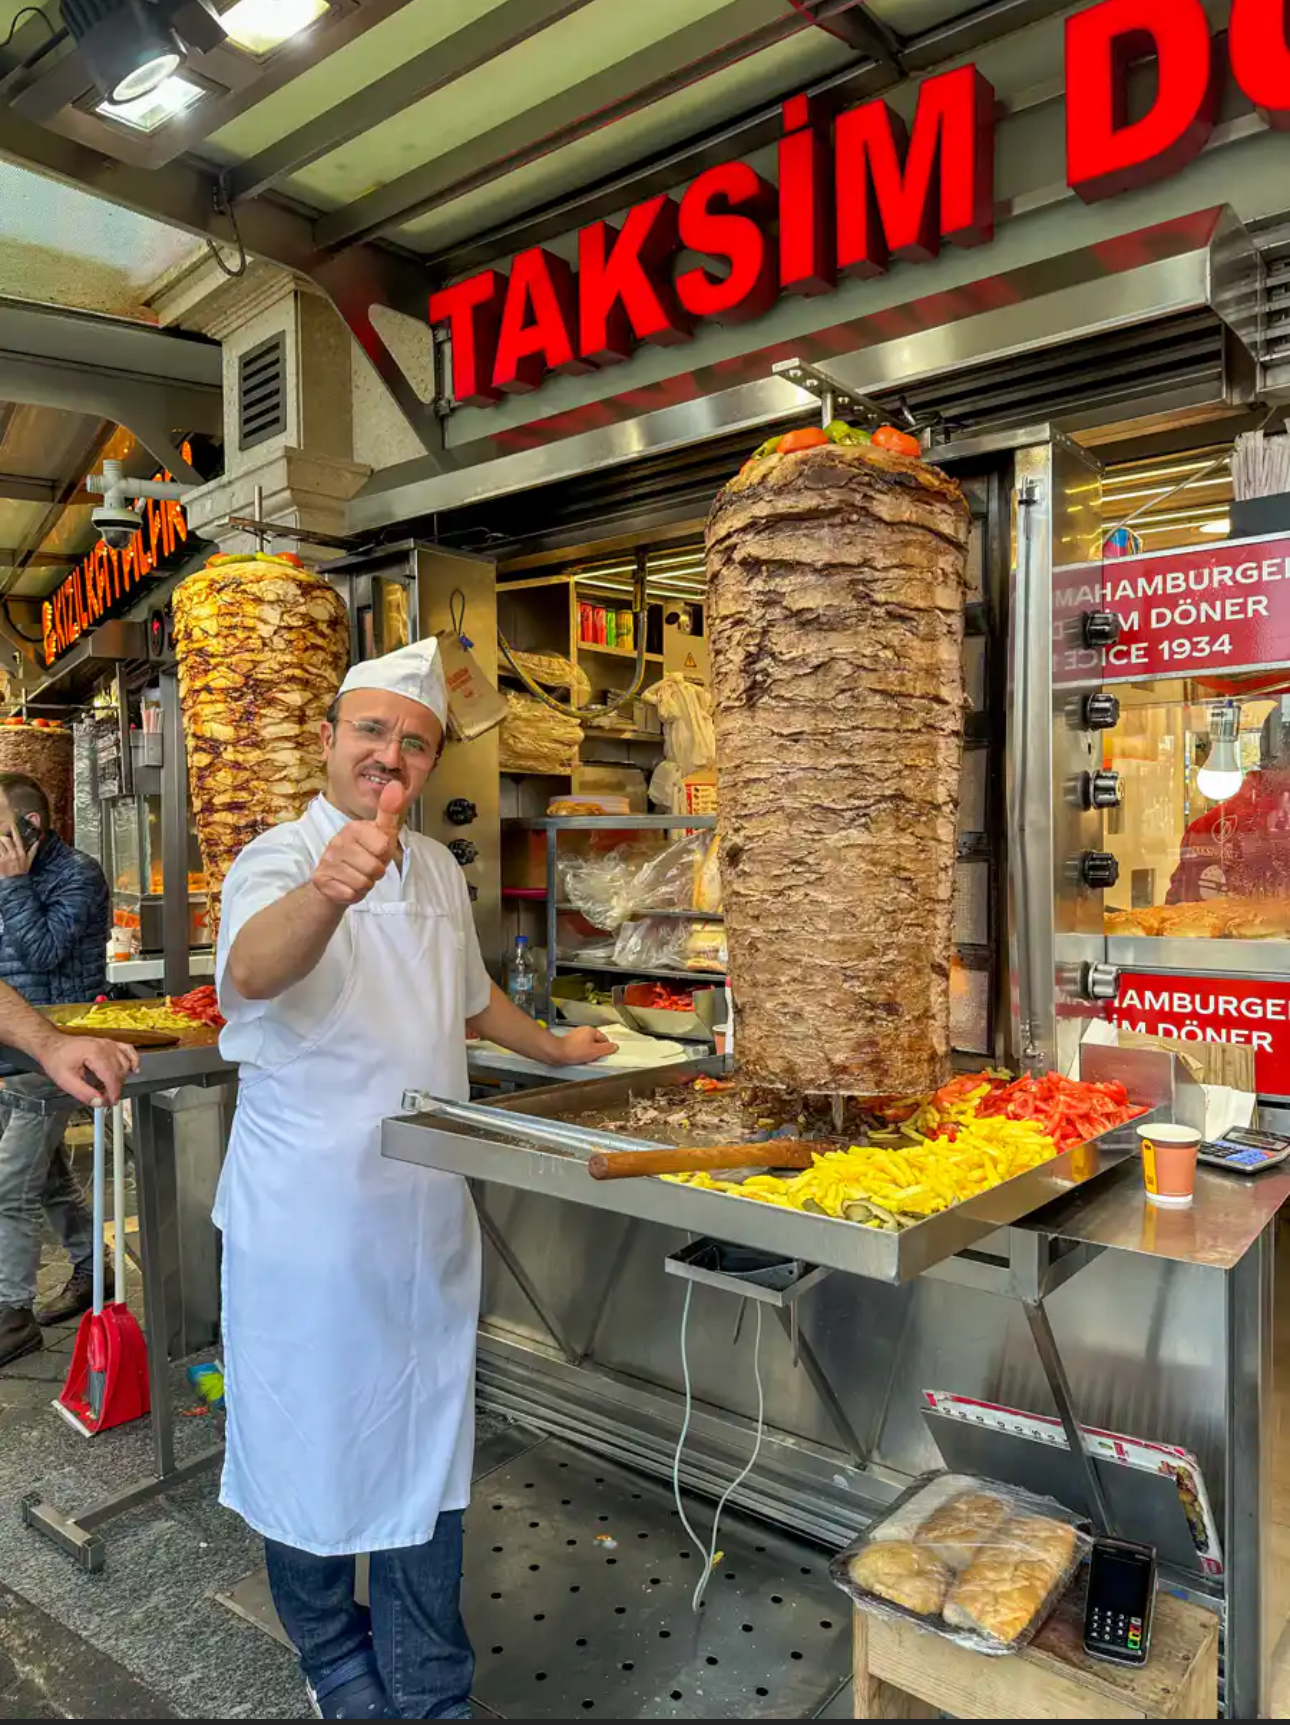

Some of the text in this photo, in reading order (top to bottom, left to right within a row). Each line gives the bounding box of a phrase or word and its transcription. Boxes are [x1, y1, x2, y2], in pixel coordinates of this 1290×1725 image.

[429, 0, 1290, 401] TAKSİM D
[1151, 596, 1269, 629] DÖNER
[1158, 633, 1233, 660] 1934
[1114, 988, 1290, 1020] AMBURGE
